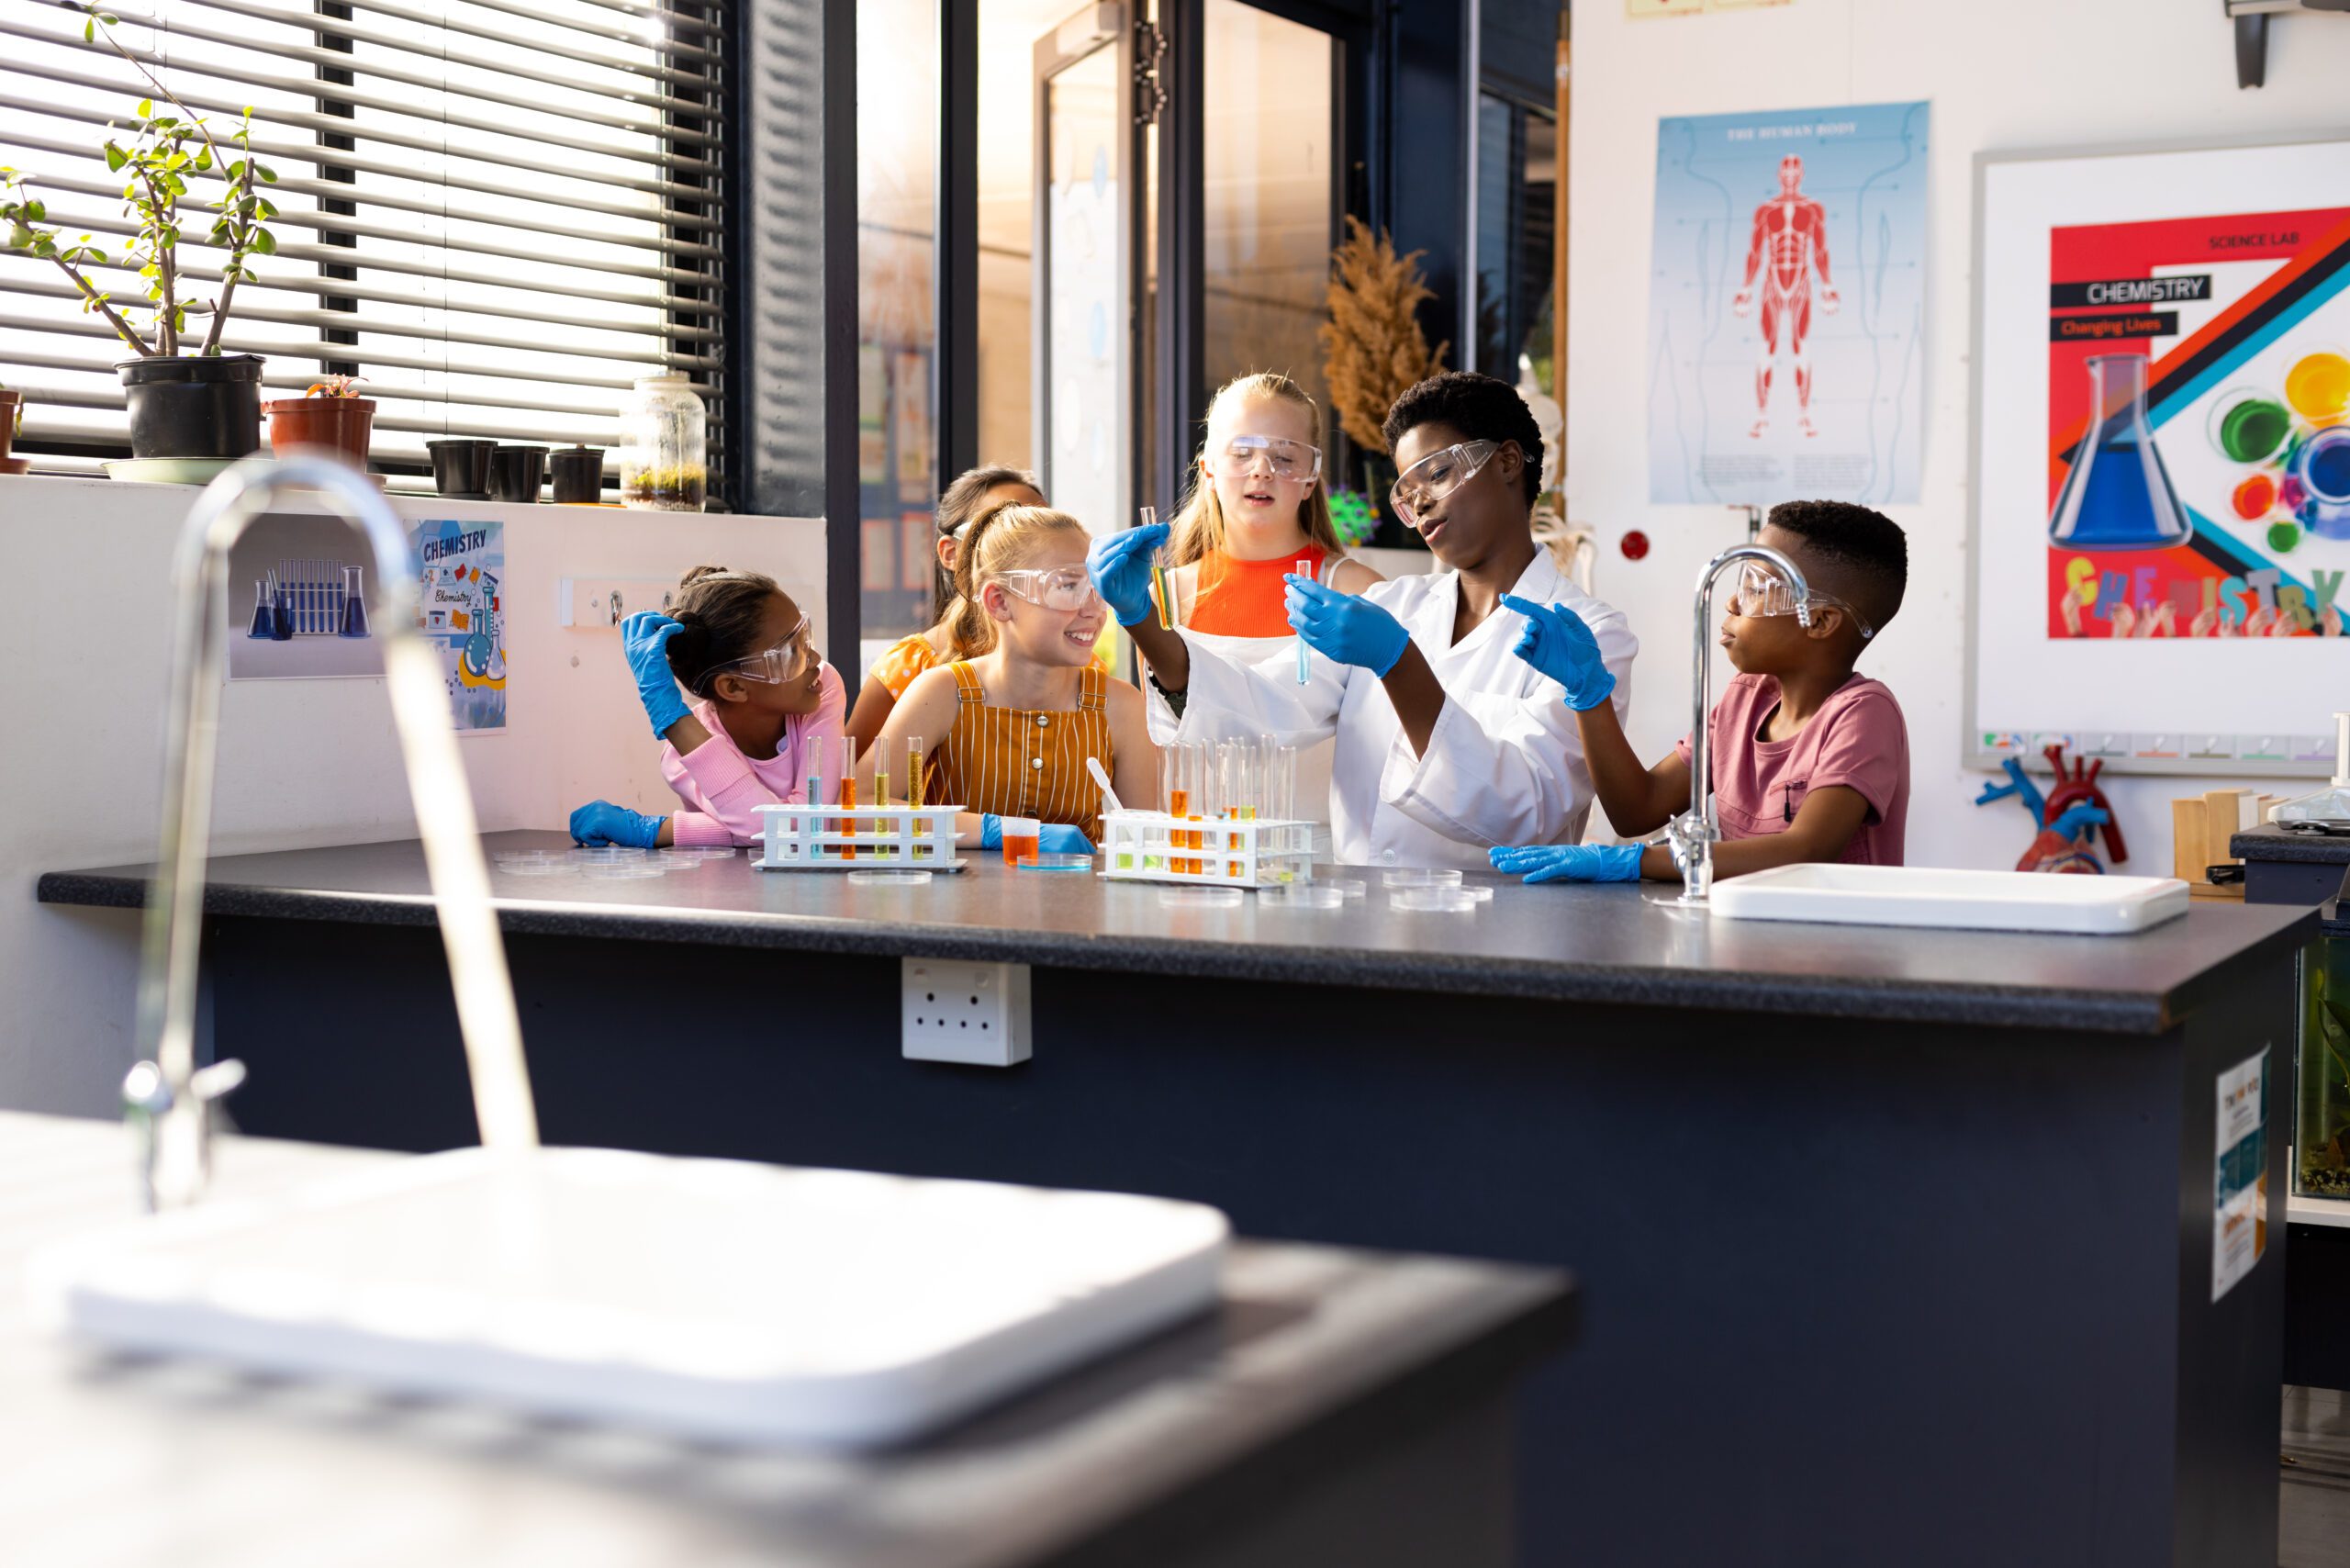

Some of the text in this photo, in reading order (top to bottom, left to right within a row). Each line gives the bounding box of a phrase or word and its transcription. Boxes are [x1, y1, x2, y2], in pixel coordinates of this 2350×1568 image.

[1727, 121, 1858, 141] THE HUMAN BODY
[2209, 231, 2300, 250] SCIENCE LAB
[2087, 276, 2204, 305] CHEMISTRY
[2061, 318, 2162, 337] Changing Lives
[424, 529, 487, 563] CHEMISTRY
[435, 588, 472, 607] Chemistry
